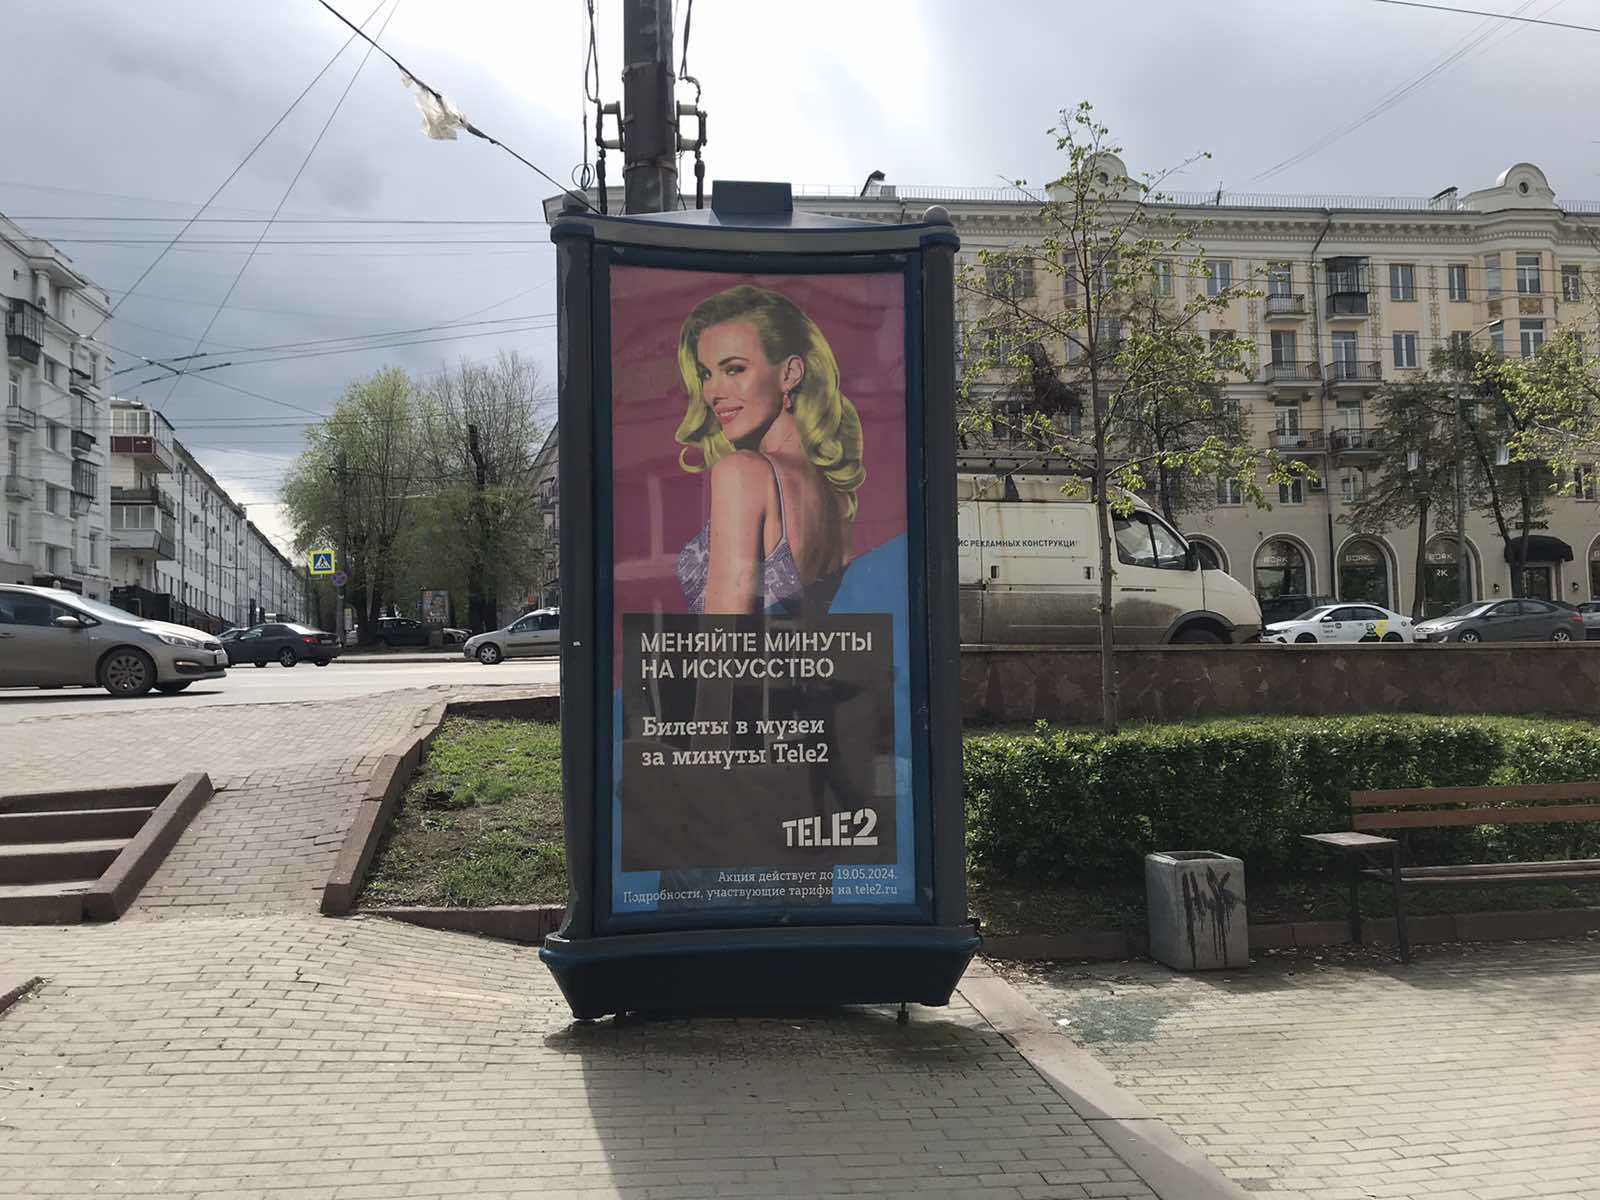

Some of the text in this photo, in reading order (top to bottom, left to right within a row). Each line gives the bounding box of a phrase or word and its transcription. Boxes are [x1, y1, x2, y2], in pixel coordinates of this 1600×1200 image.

[970, 540, 1021, 548] РЕКЛАМНЫХ
[640, 628, 873, 653] МЕНЯЙТЕ МИНУТЫ
[641, 658, 835, 680] НА ИСКУССТВО
[641, 716, 825, 740] Билеты в музеи
[641, 743, 830, 770] за минуты Tele2
[782, 808, 879, 847] TELE2
[717, 871, 756, 884] Акция
[758, 868, 817, 884] действует
[819, 870, 835, 883] до
[707, 885, 786, 901] участвующие
[788, 883, 834, 899] тарифы
[838, 885, 852, 897] на
[855, 883, 898, 897] tele2.ru
